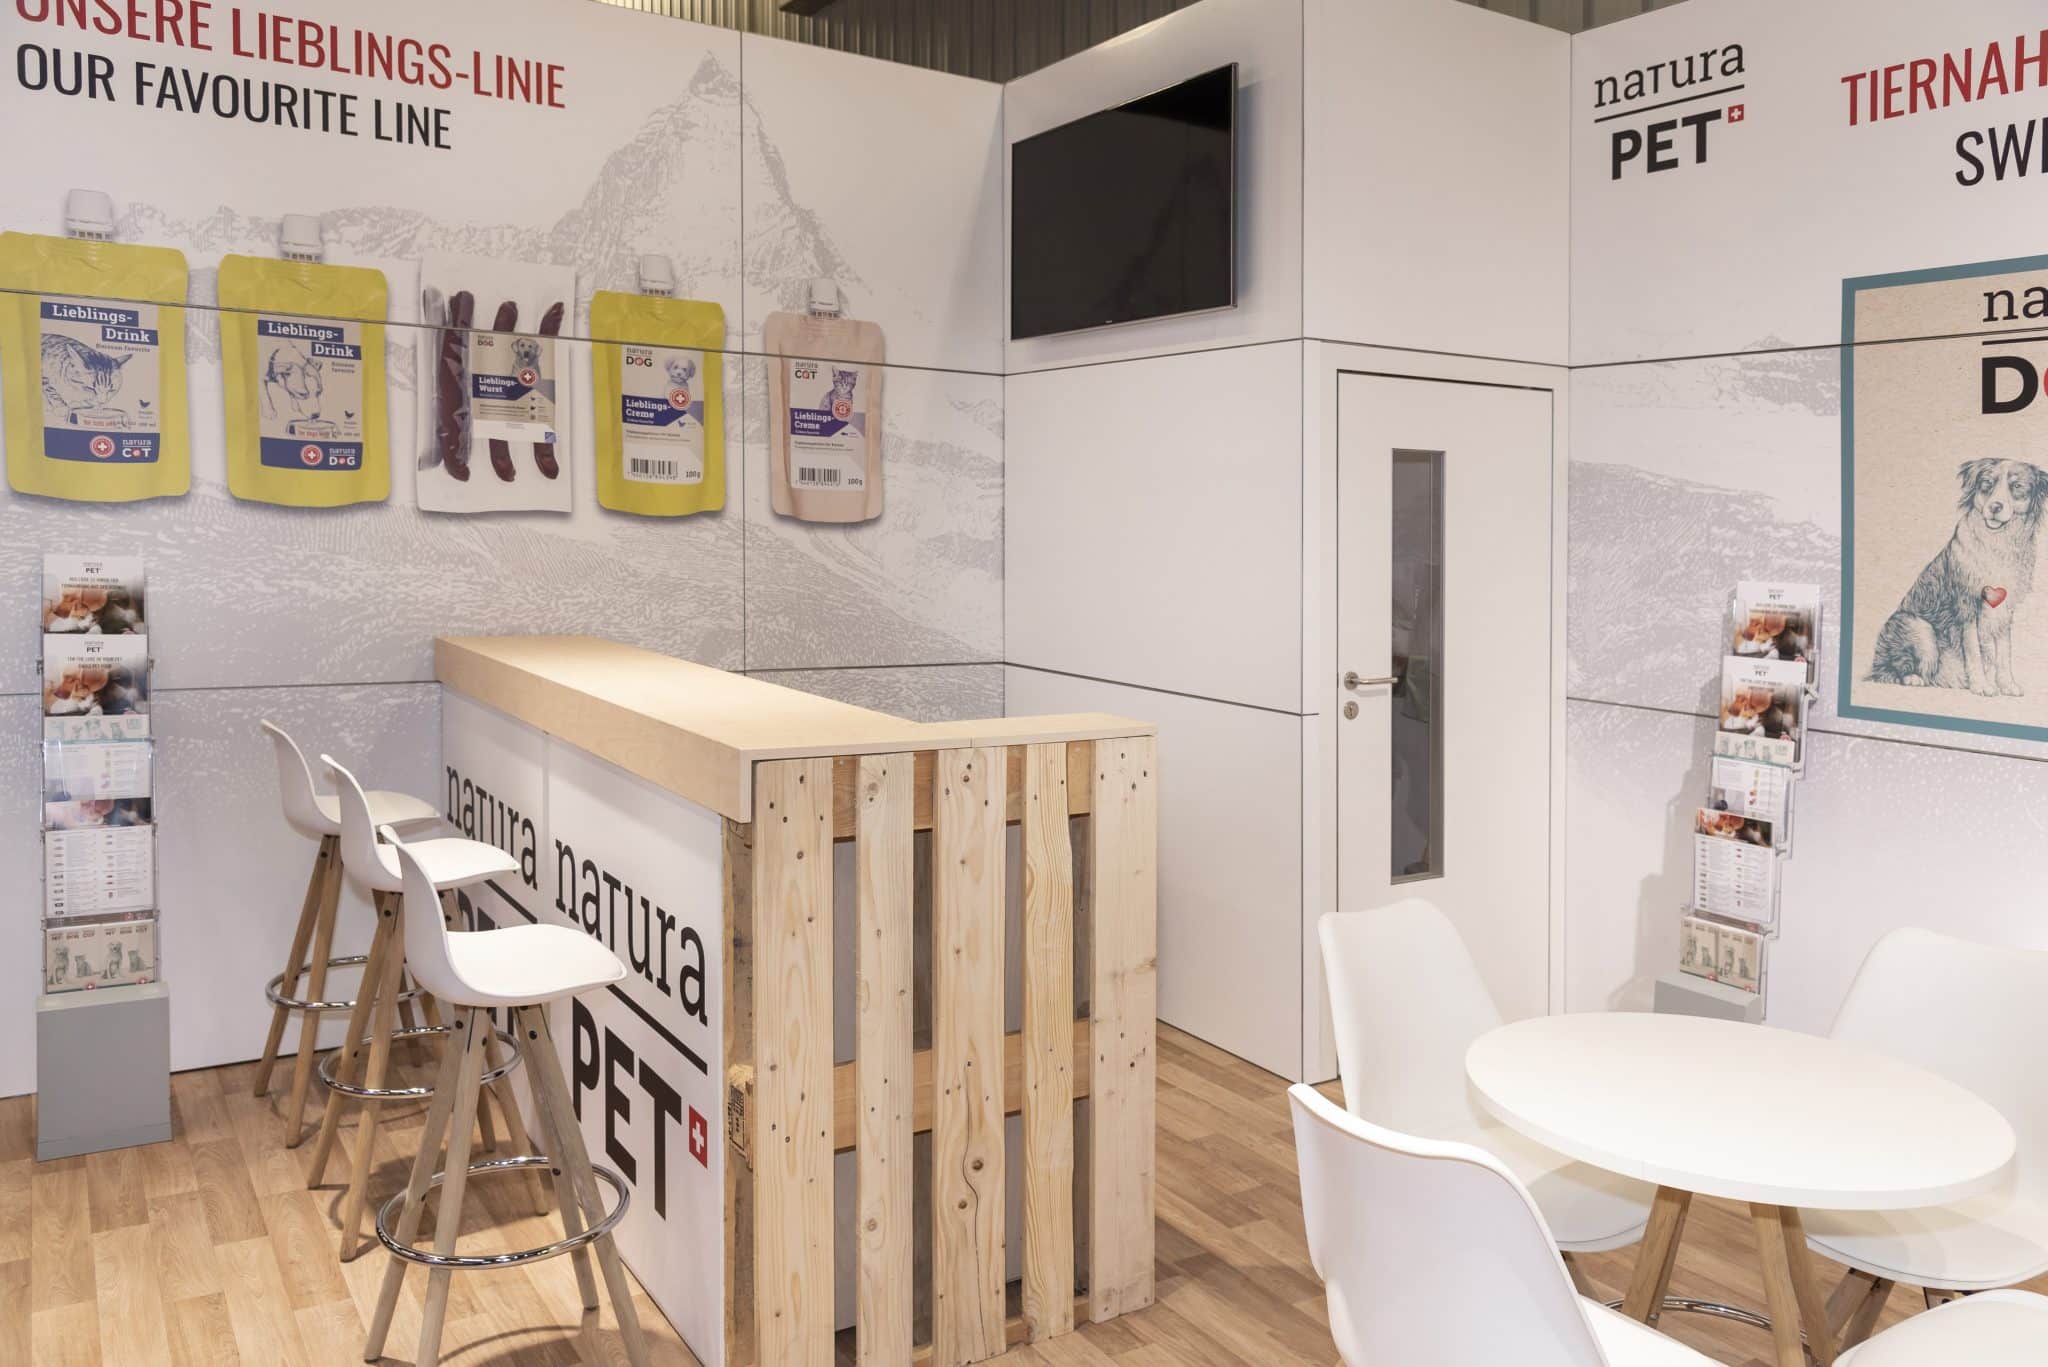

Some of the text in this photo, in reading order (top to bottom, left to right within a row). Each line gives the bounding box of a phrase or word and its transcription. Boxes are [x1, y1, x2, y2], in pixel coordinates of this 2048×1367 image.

[233, 7, 565, 108] LIEBLINGS-LINIE
[1841, 29, 2048, 126] TIERNAH
[17, 43, 451, 150] OUR FAVOURITE LINE
[1611, 109, 1722, 181] PET
[52, 304, 133, 324] Lieblings-
[106, 328, 150, 342] Drink
[268, 322, 338, 341] Lieblings-
[315, 344, 354, 358] Drink
[626, 356, 652, 367] DOG
[479, 385, 502, 393] Wurst
[1982, 356, 2048, 414] D
[626, 400, 671, 411] Lieblings-
[626, 408, 655, 418] Creme
[794, 421, 820, 429] Creme
[329, 456, 355, 465] DOG
[572, 996, 682, 1221] PET
